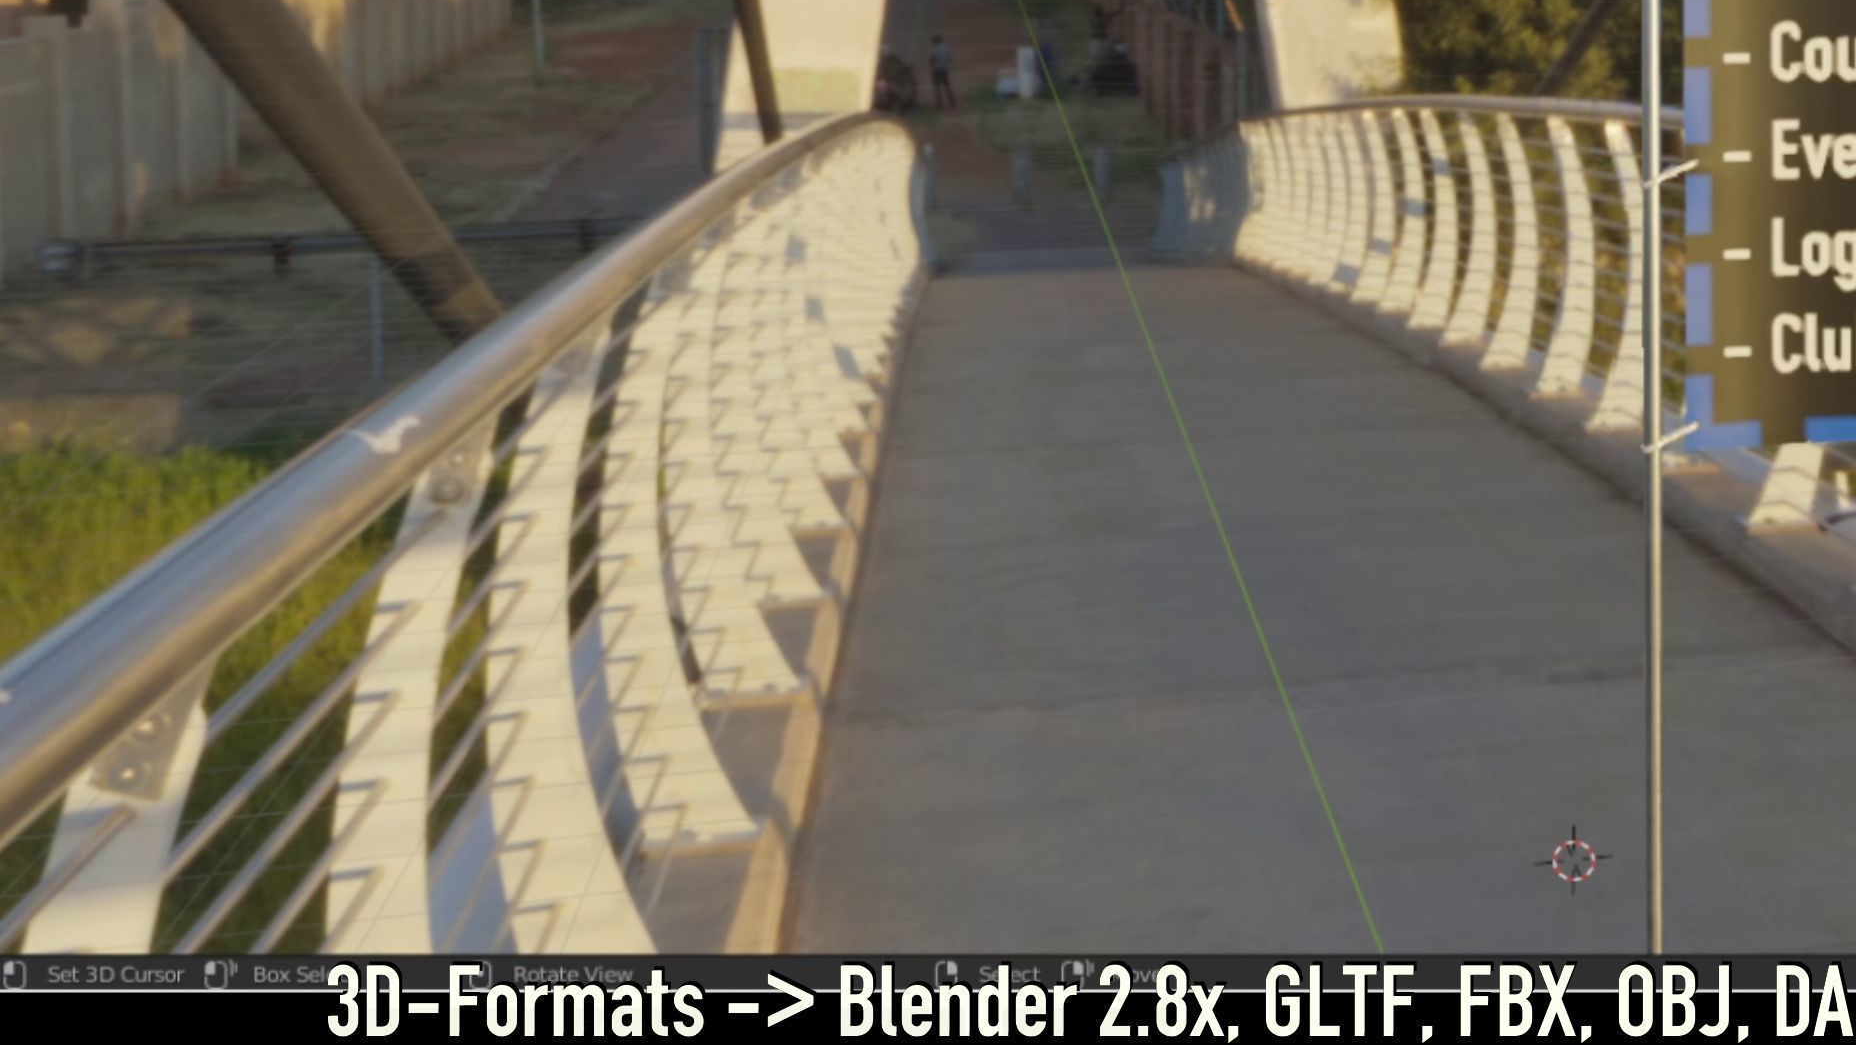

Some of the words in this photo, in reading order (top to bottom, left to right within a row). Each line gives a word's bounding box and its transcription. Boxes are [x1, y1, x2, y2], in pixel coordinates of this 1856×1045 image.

[48, 965, 79, 983] Set
[86, 965, 115, 983] 3D
[121, 965, 186, 983] Cursor
[254, 965, 291, 983] Box
[513, 965, 580, 983] Rotate
[584, 965, 634, 983] View
